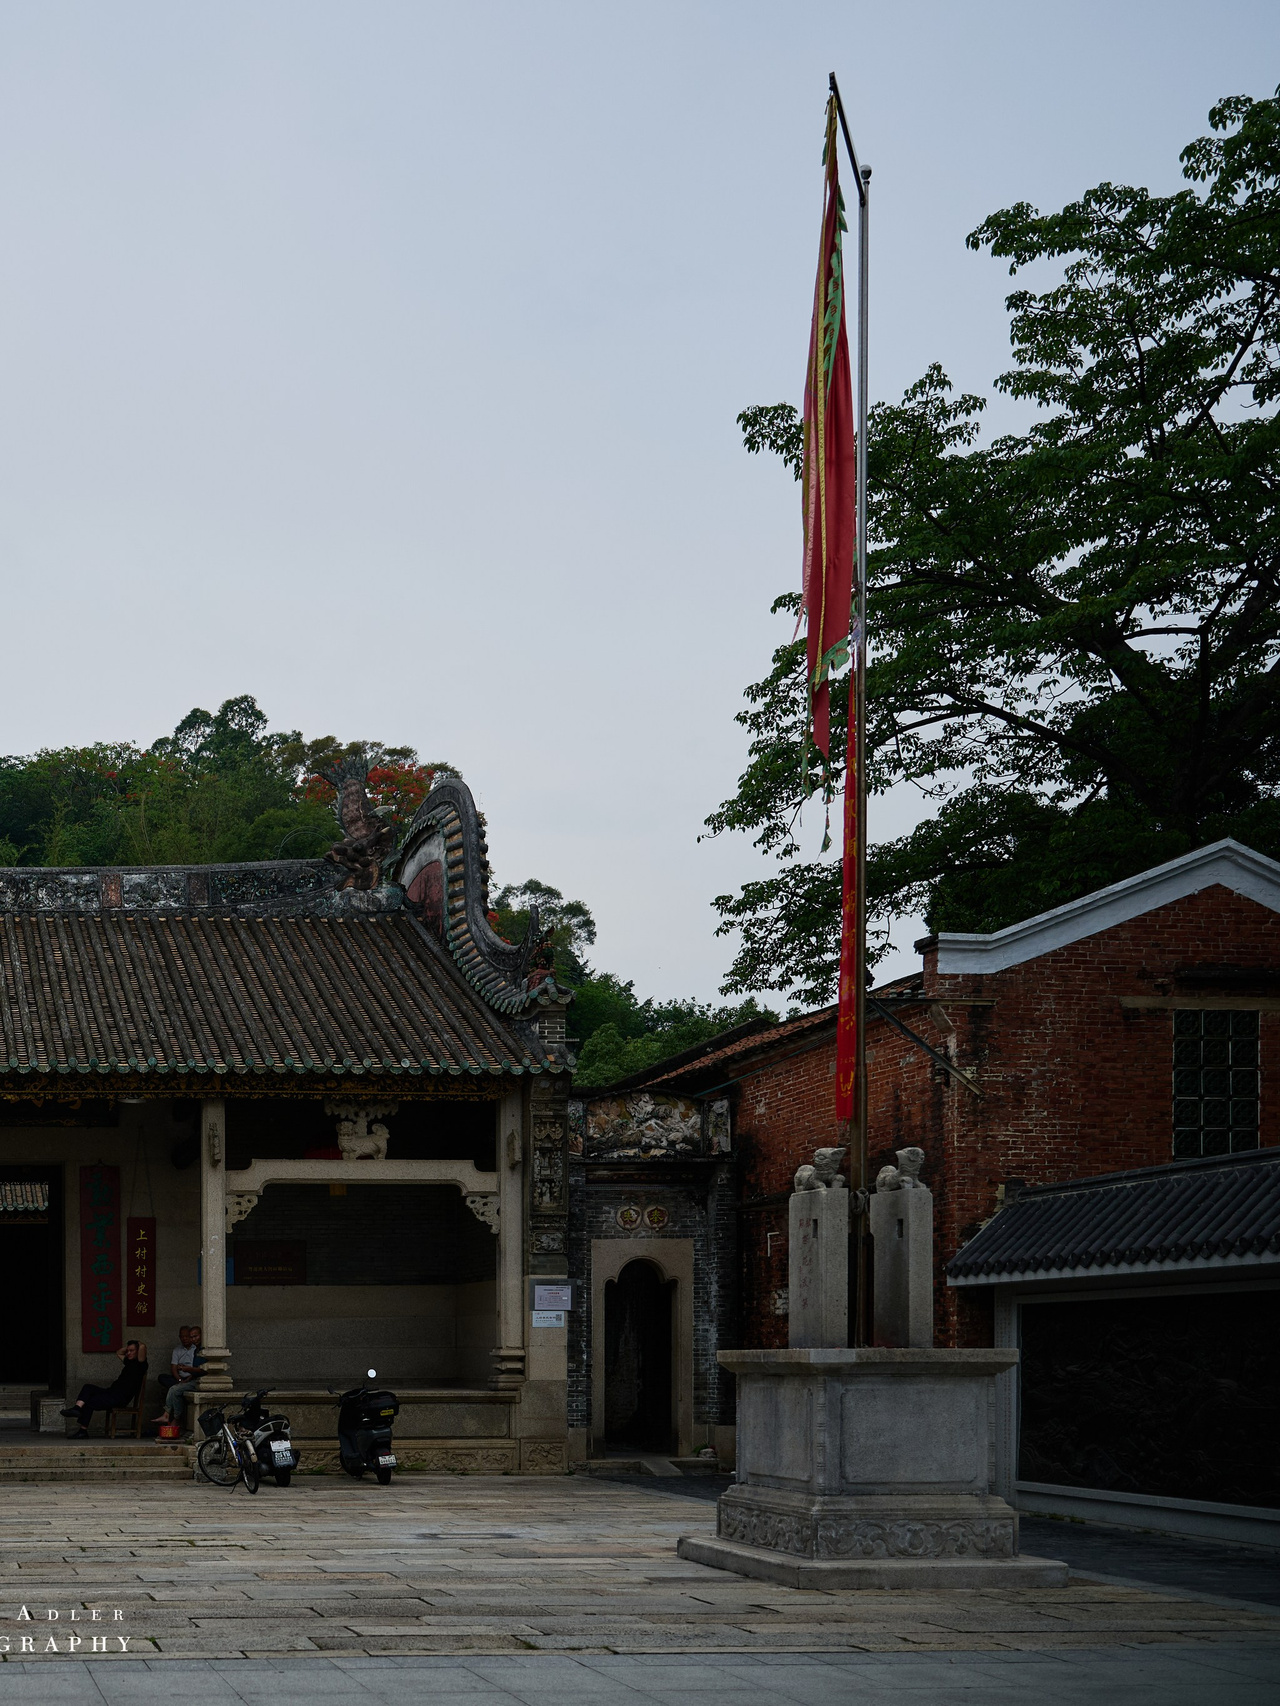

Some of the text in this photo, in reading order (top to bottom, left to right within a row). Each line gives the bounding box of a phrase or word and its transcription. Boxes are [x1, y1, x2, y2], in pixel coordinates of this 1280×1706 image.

[134, 1229, 149, 1314] 上村村史館
